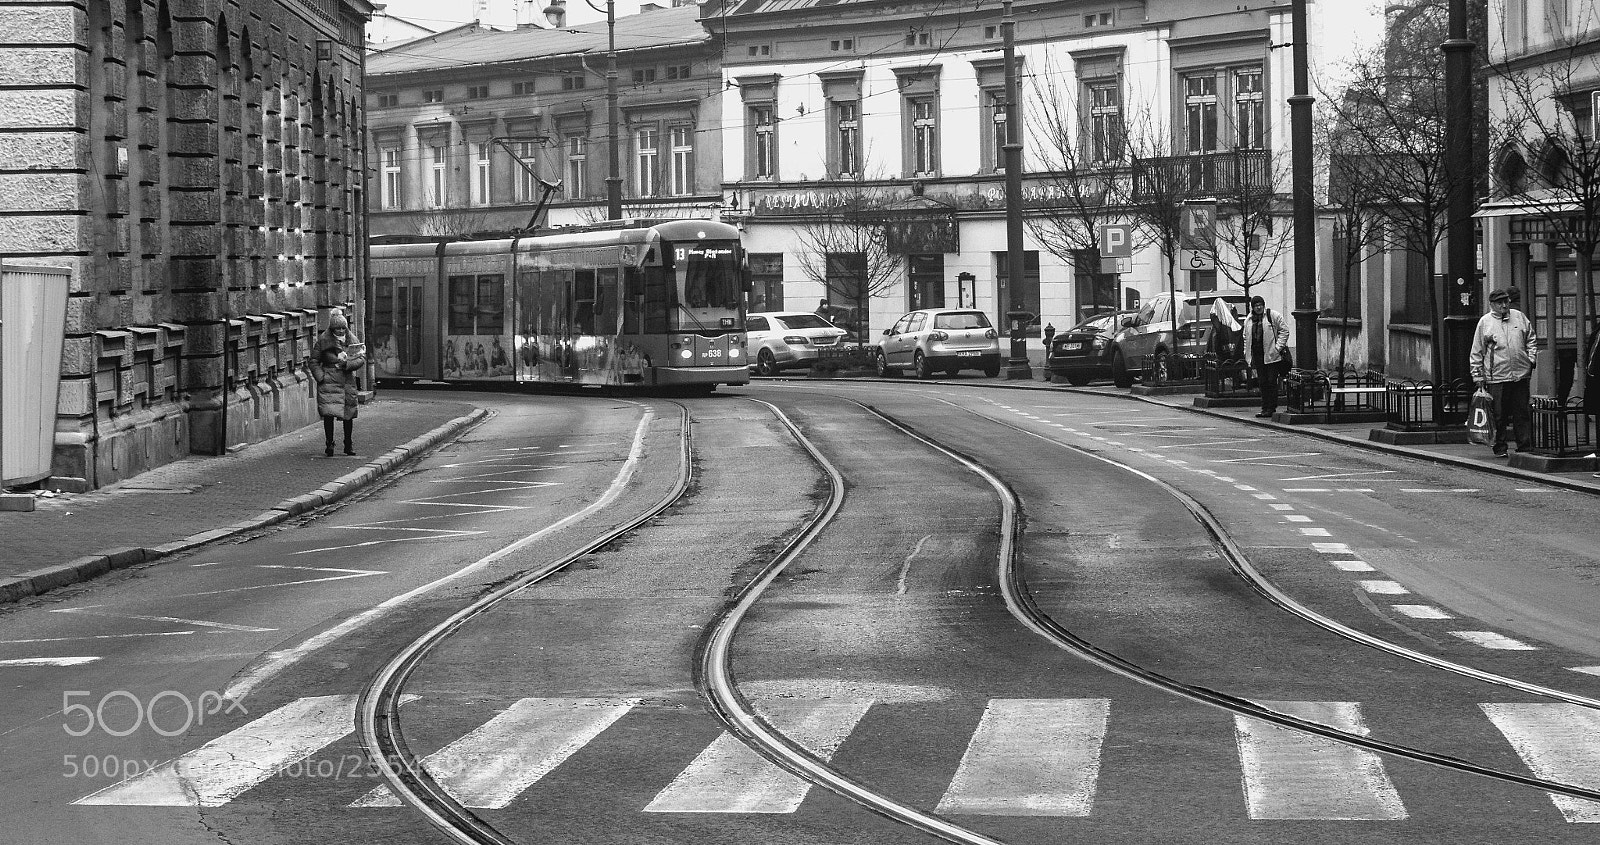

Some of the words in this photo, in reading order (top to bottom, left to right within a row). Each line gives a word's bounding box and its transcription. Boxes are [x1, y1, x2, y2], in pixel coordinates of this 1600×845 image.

[765, 191, 849, 210] RESTAURACJA
[1188, 208, 1209, 236] P
[1106, 228, 1125, 253] P
[675, 248, 685, 261] 13
[708, 349, 722, 358] 638
[1473, 407, 1488, 428] D
